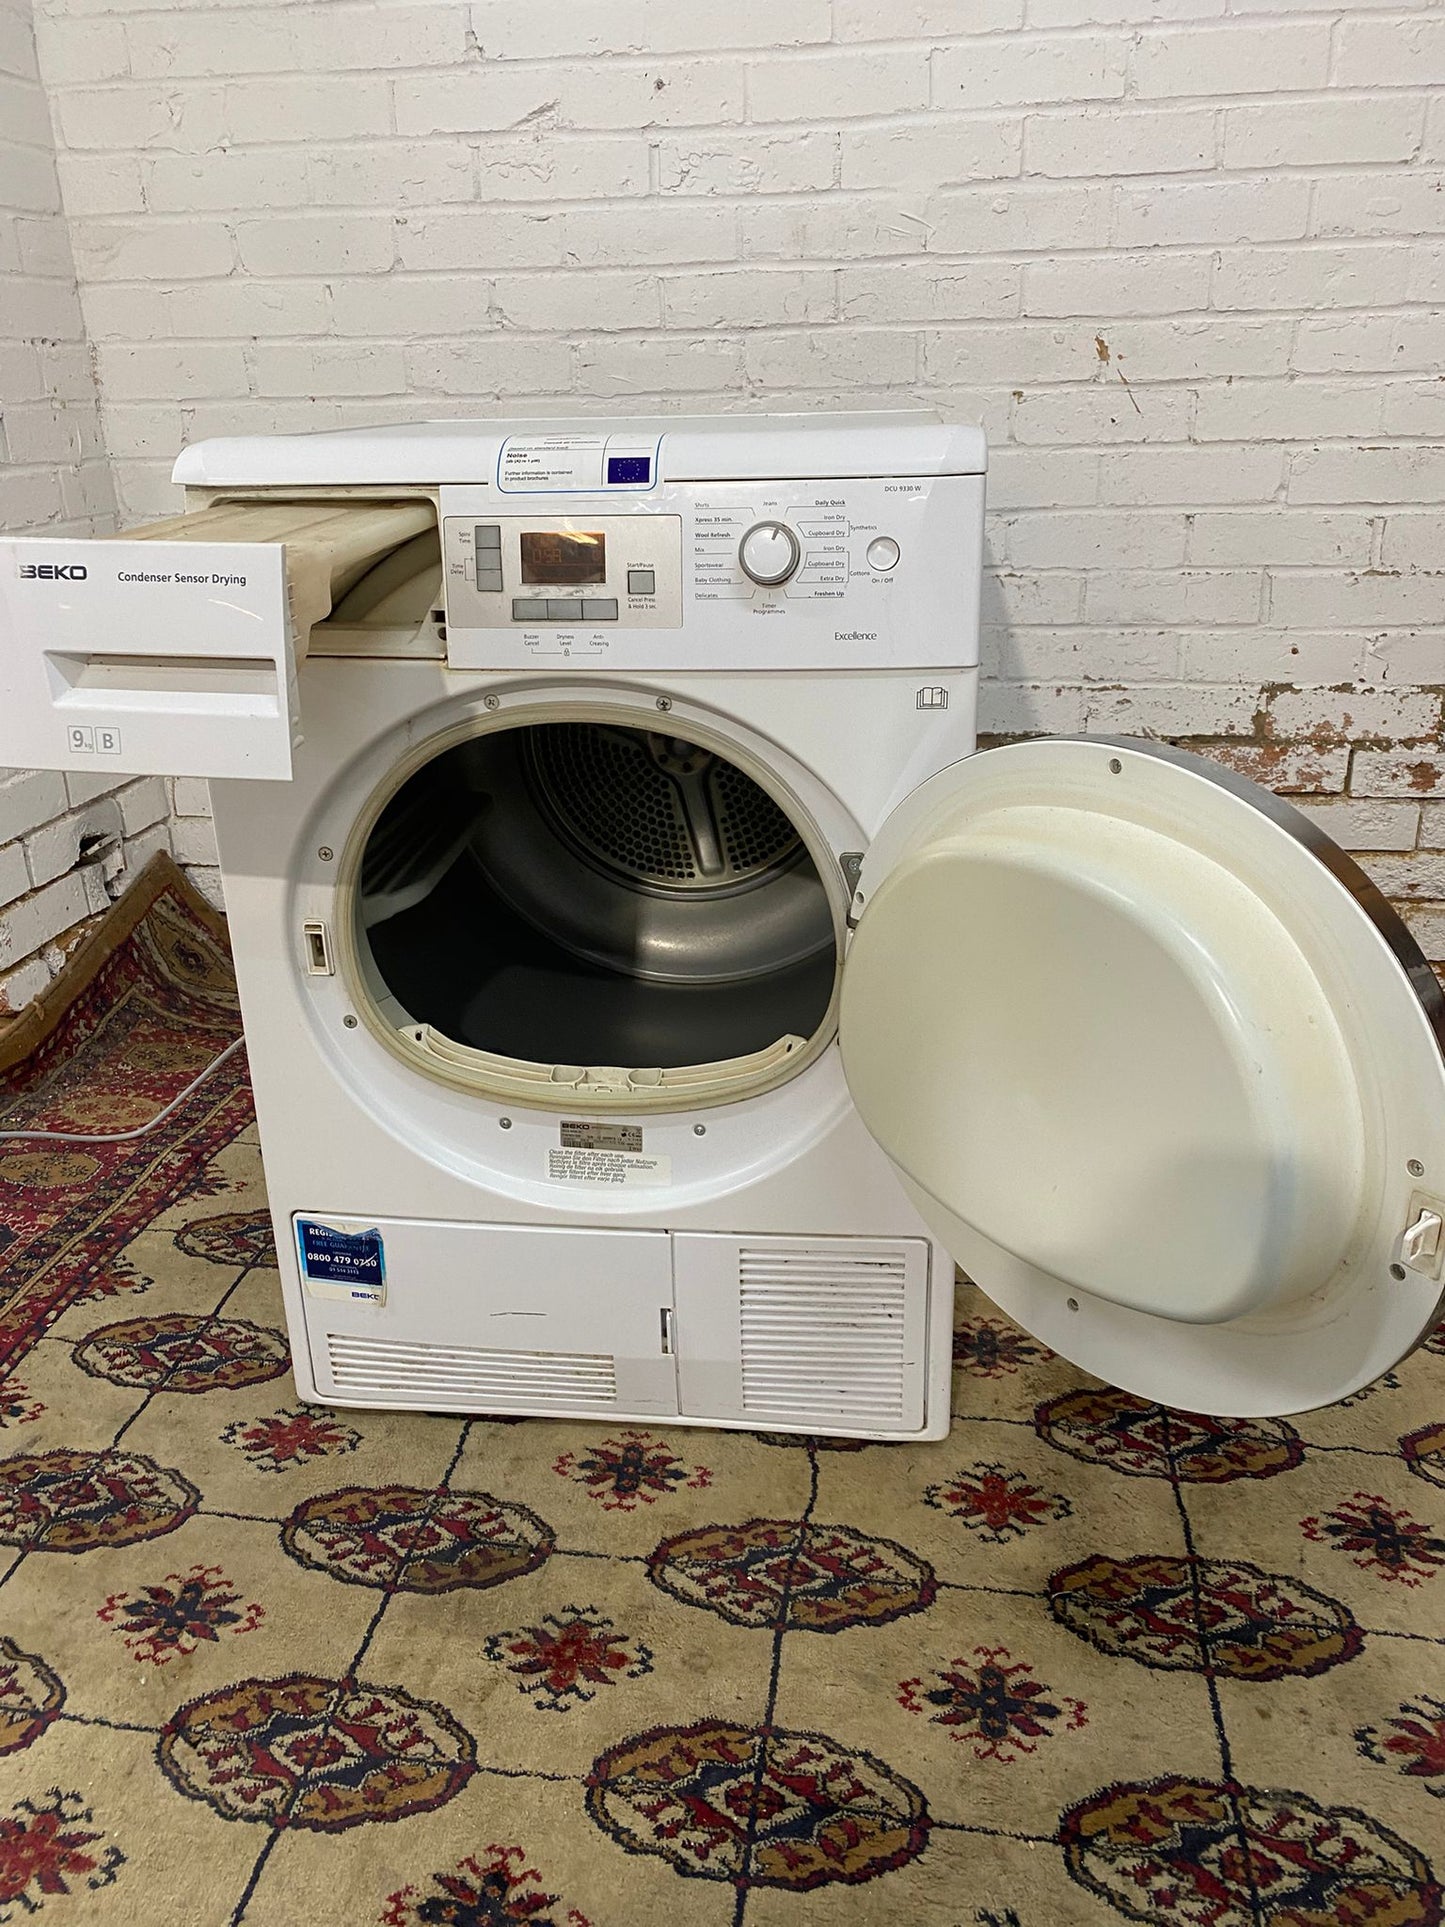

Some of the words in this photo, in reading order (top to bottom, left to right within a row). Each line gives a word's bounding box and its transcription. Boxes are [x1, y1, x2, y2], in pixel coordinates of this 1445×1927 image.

[19, 565, 88, 580] BEKO
[118, 572, 171, 582] Condenser
[174, 573, 209, 583] Sensor
[212, 574, 247, 587] Drying
[835, 631, 878, 641] Excellence
[103, 733, 114, 749] B
[562, 1122, 590, 1130] BEKO
[307, 1252, 331, 1262] 0800
[333, 1256, 351, 1264] 479
